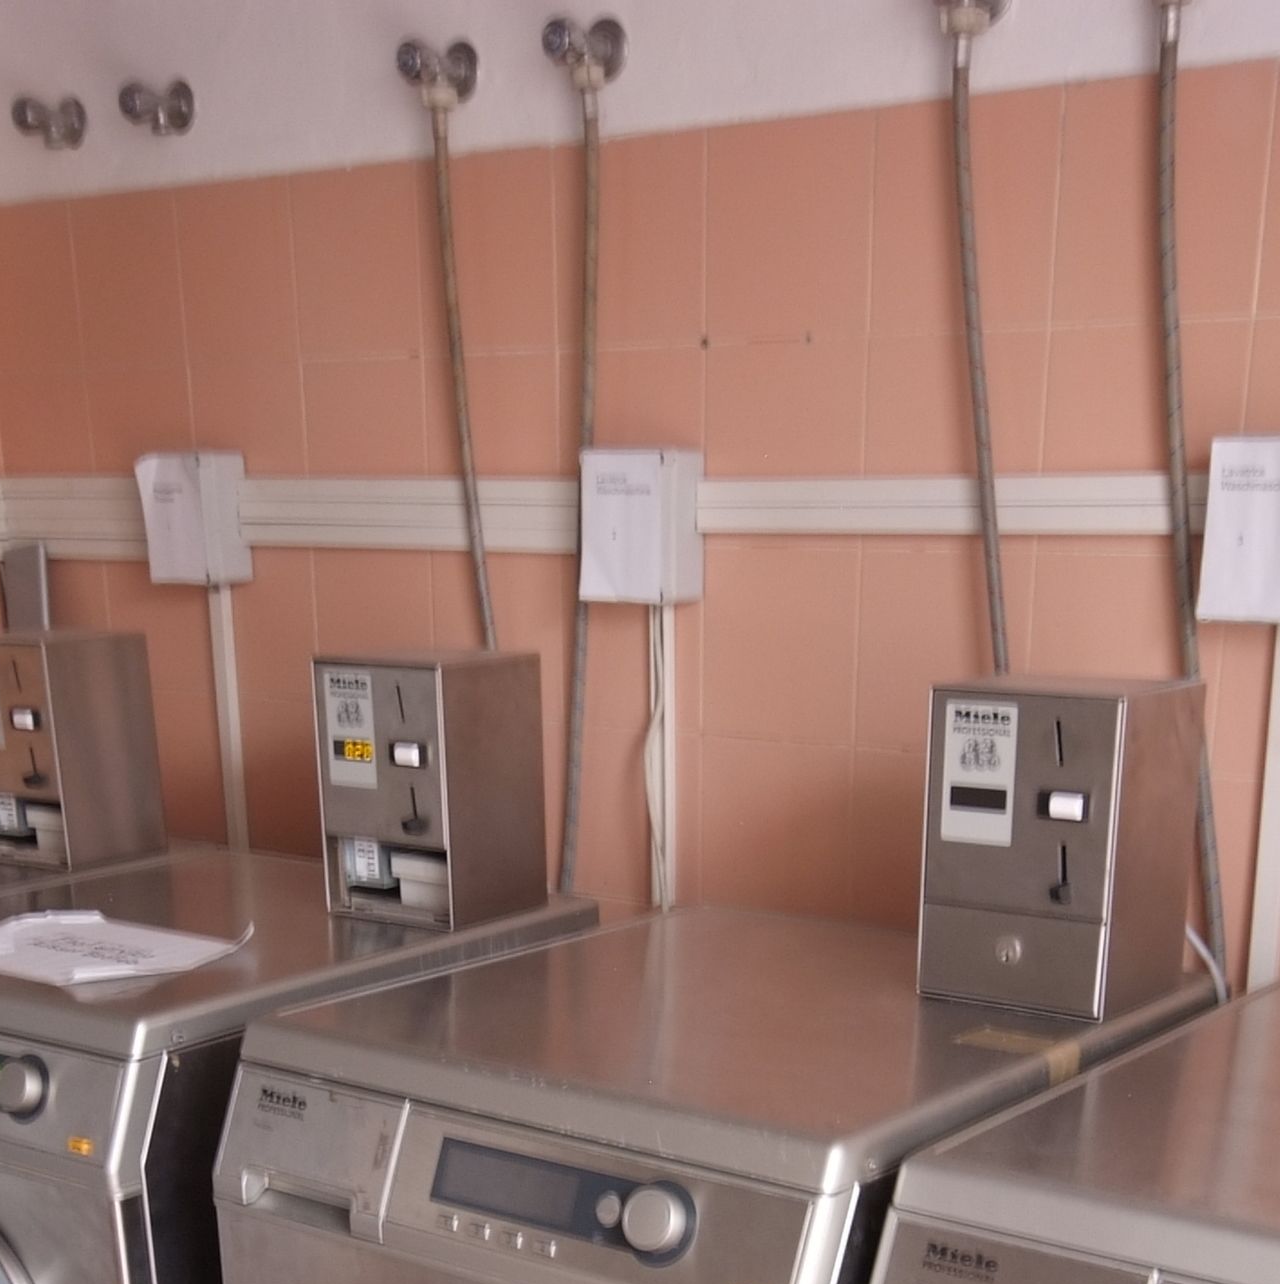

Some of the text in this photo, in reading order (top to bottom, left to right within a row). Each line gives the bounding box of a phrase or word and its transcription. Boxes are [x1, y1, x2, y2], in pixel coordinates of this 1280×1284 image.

[328, 676, 368, 690] Miele
[954, 709, 1012, 726] Miele
[260, 1088, 307, 1111] Miele
[925, 1243, 998, 1273] Miele
